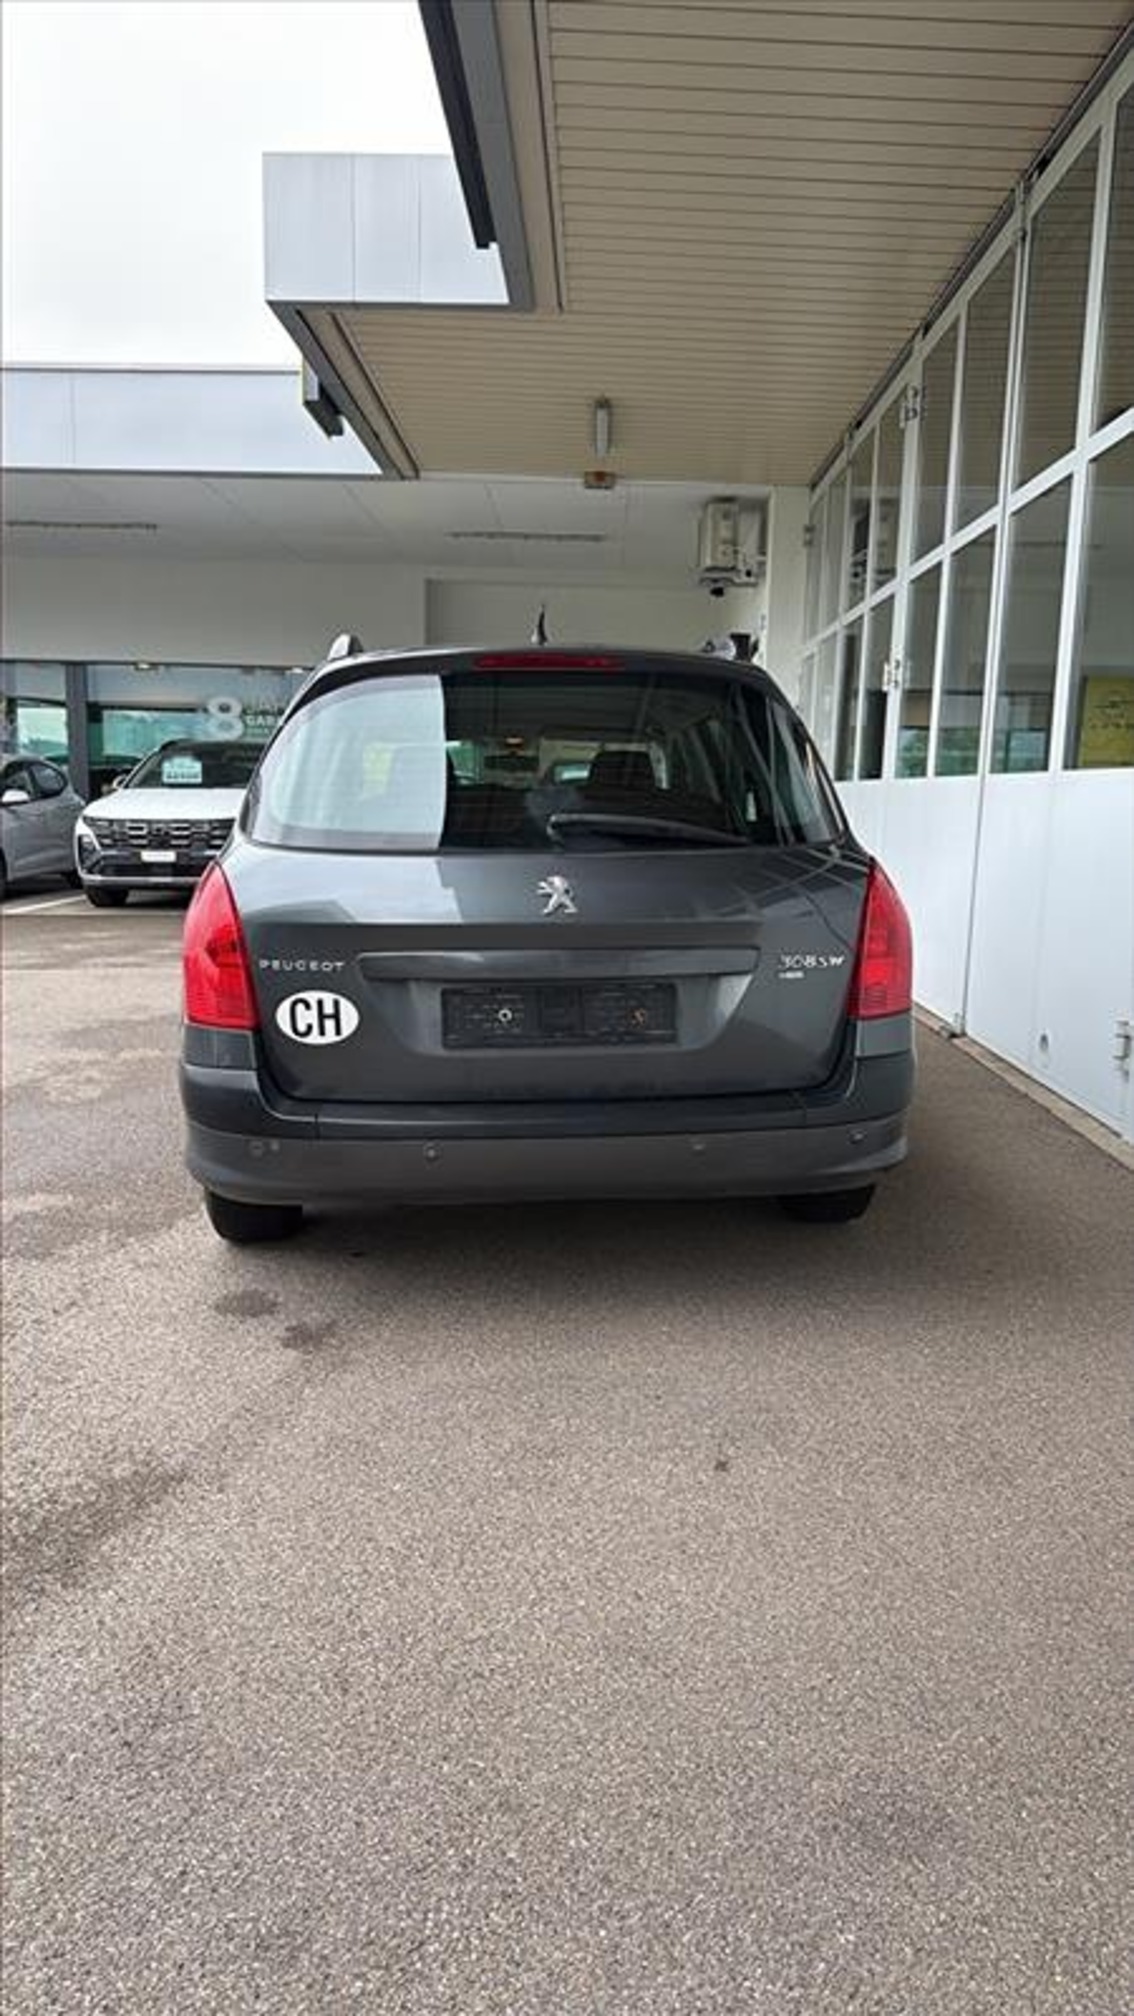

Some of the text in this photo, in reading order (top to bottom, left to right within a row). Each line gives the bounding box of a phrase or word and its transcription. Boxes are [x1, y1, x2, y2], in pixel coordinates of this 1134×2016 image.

[207, 697, 245, 741] 8
[259, 959, 346, 972] PEUGEOT
[289, 997, 342, 1038] CH
